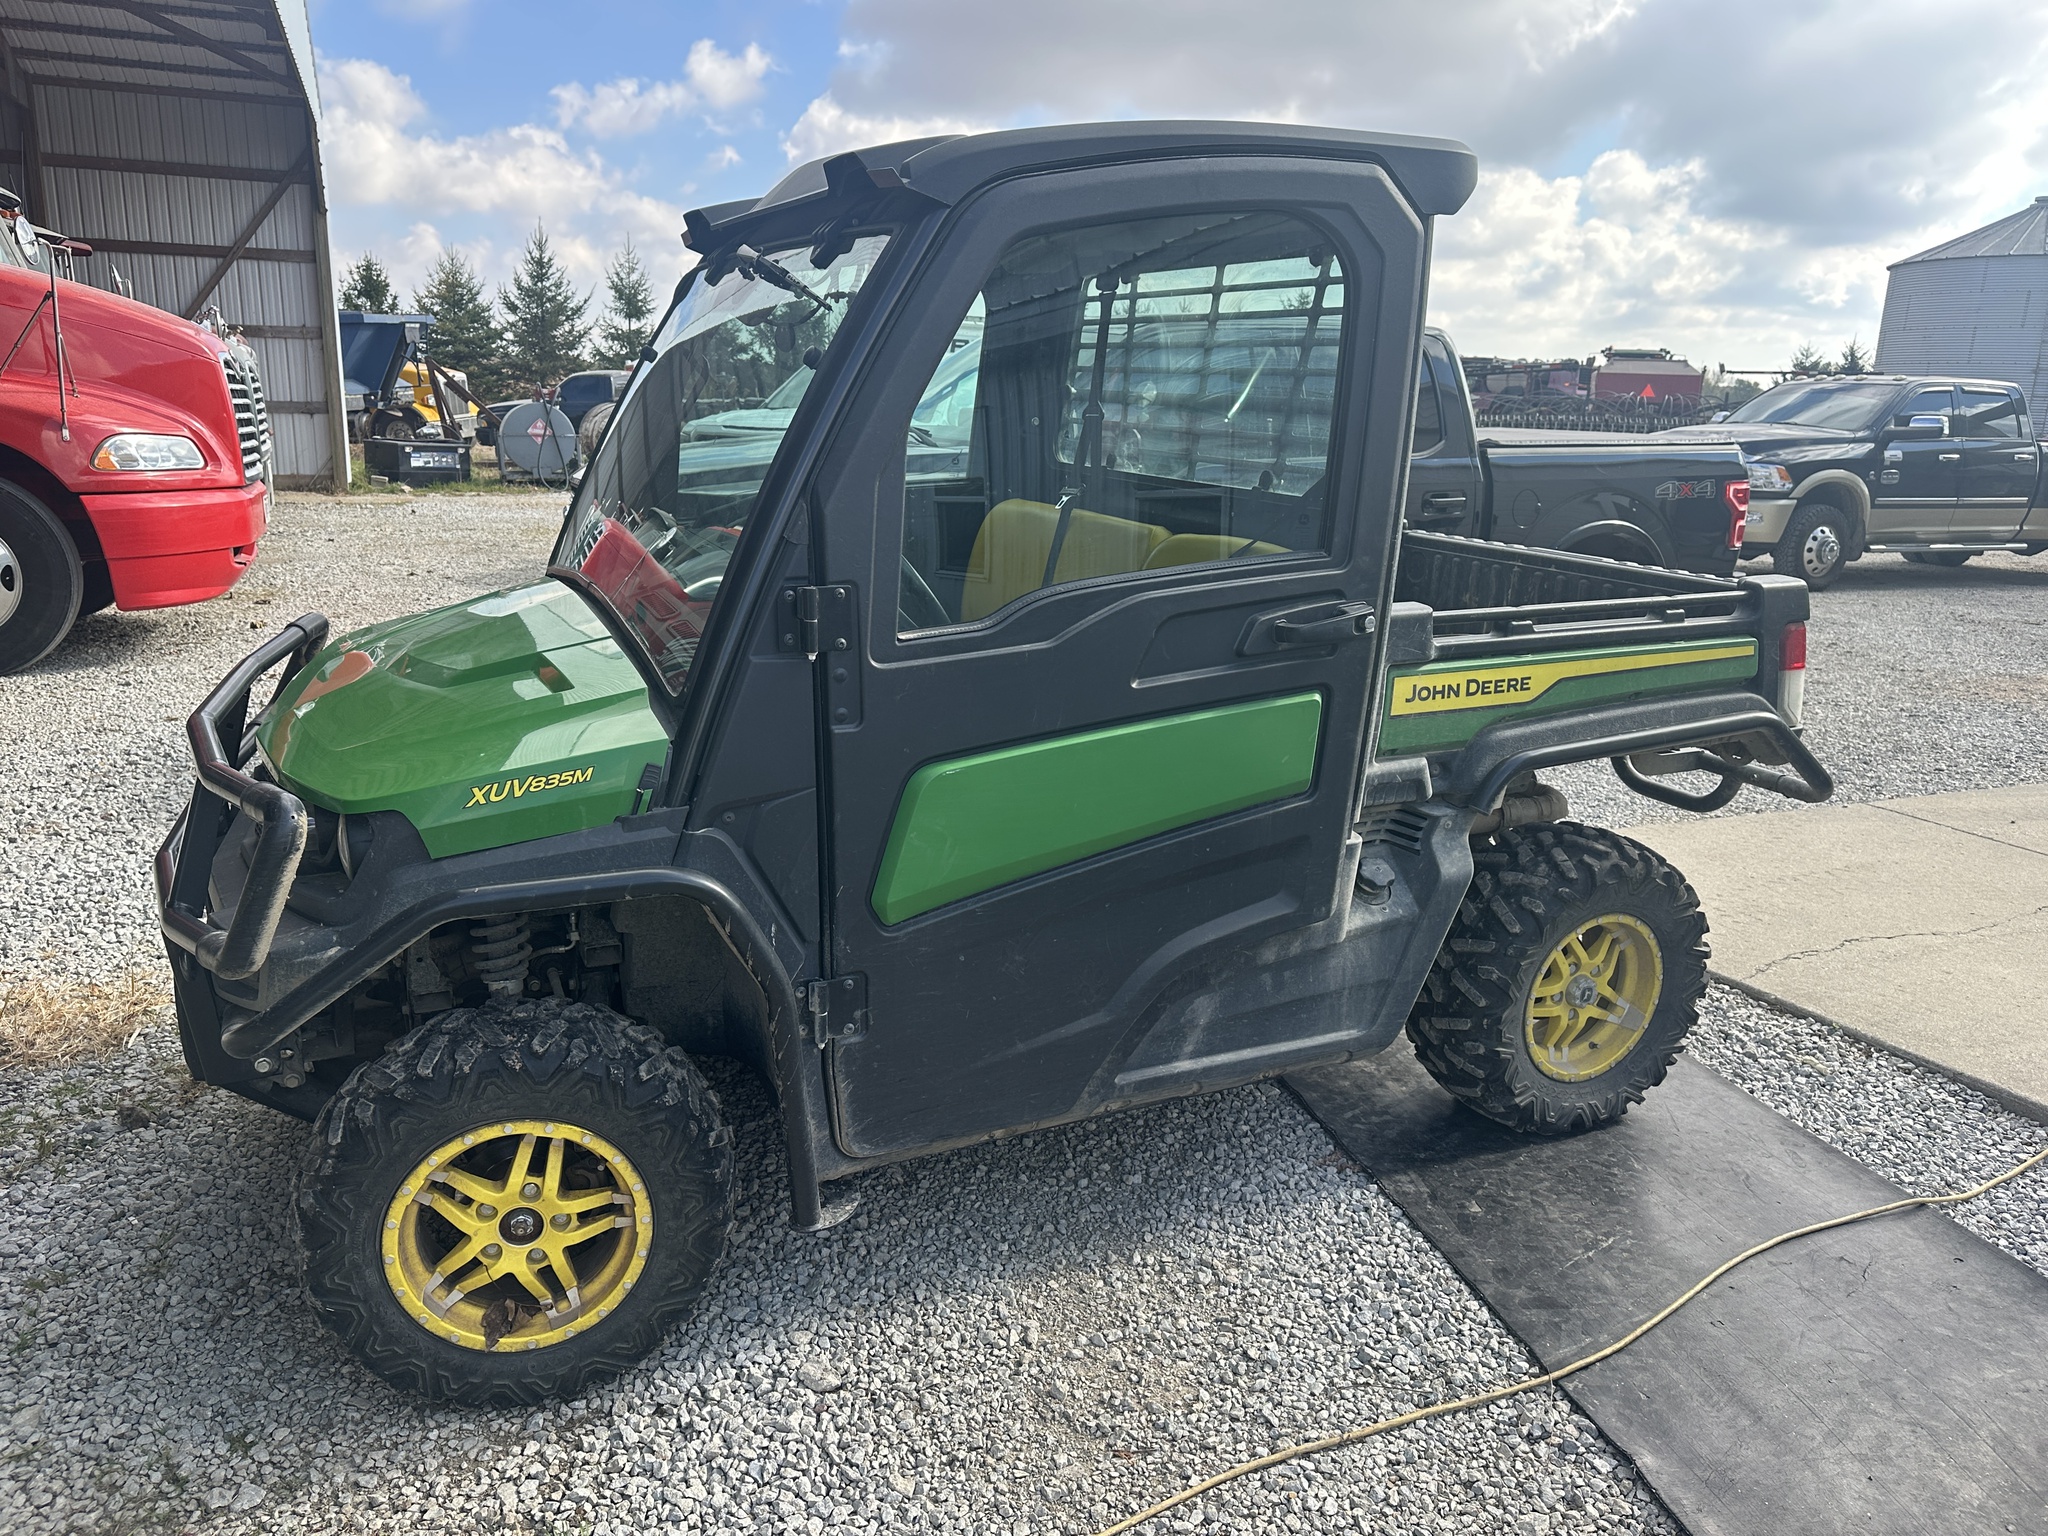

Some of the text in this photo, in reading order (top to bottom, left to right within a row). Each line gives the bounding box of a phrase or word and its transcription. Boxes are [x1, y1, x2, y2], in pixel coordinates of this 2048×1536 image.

[1405, 676, 1532, 703] JOHN DEERE
[462, 766, 595, 809] XUV835M
